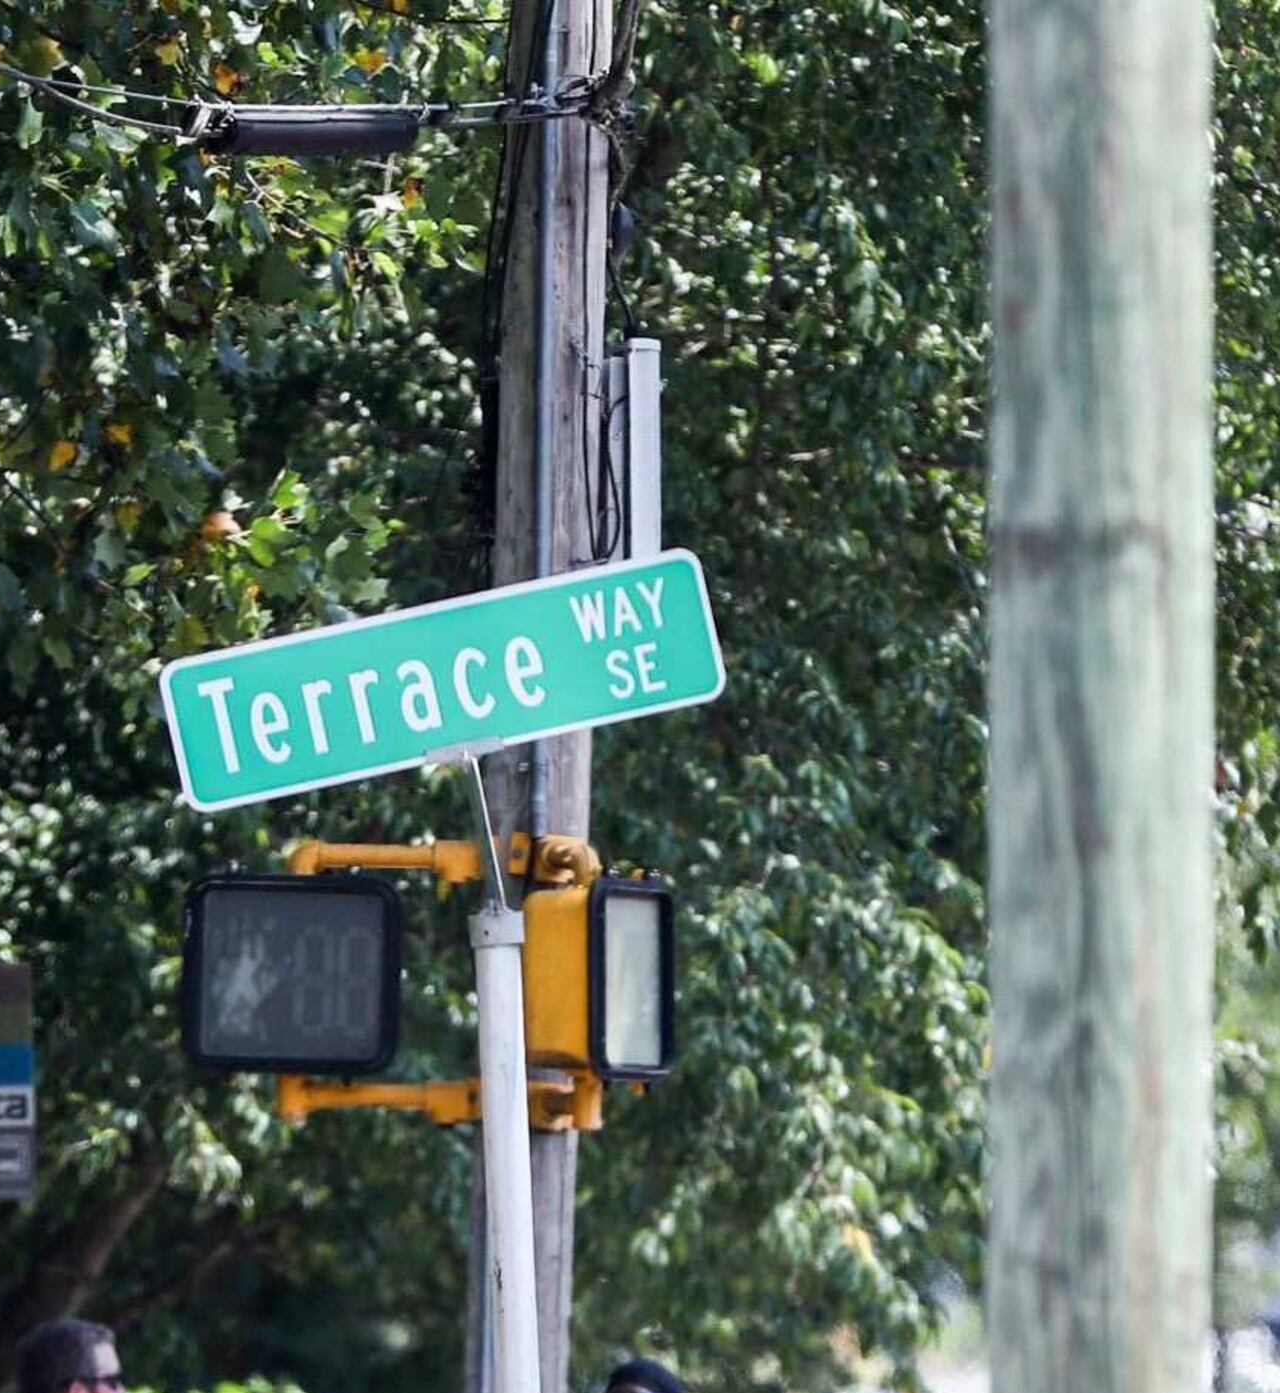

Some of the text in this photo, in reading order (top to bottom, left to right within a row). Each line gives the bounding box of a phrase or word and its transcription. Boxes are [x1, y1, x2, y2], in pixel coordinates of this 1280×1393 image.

[197, 577, 667, 776] Terrace WAY
[605, 642, 667, 699] SE
